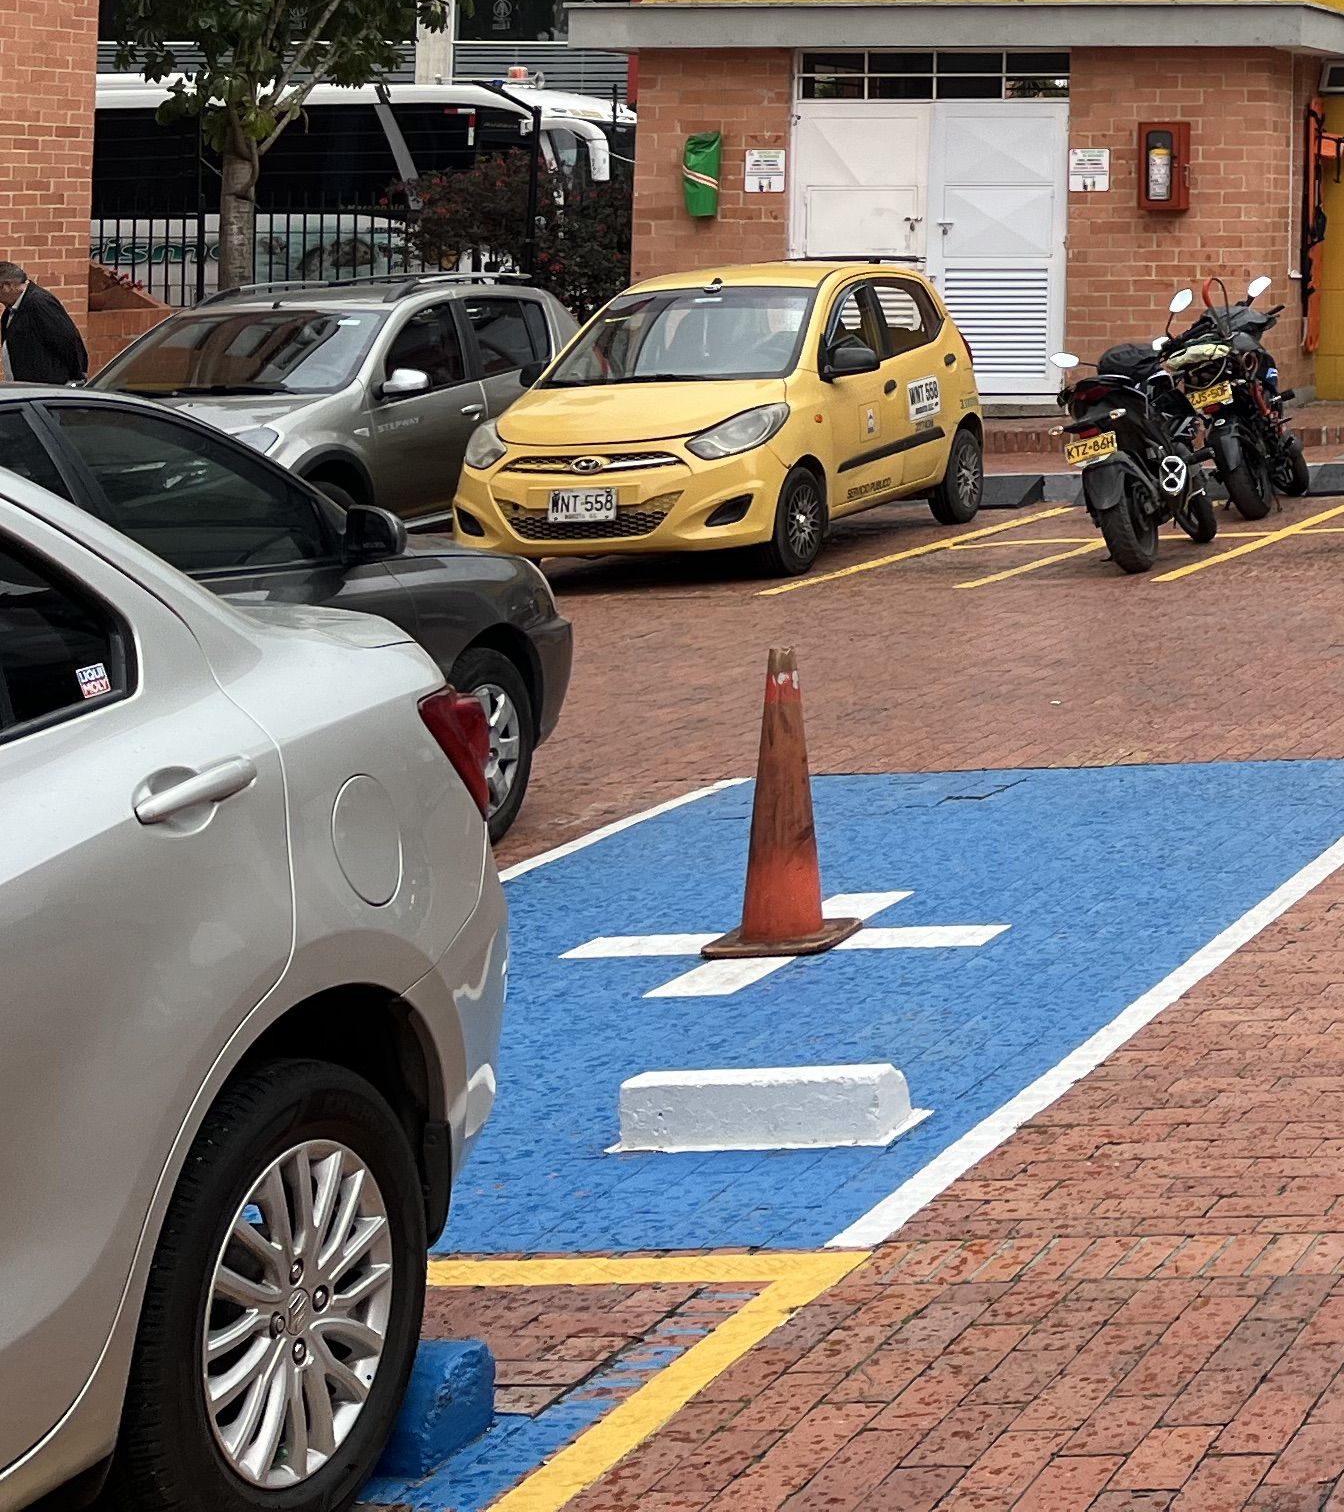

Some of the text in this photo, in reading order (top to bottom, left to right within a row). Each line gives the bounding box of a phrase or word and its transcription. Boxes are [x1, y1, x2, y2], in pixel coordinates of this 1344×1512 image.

[377, 416, 420, 433] STEPWAY
[78, 666, 105, 684] LIQUI
[82, 679, 110, 696] MOLY
